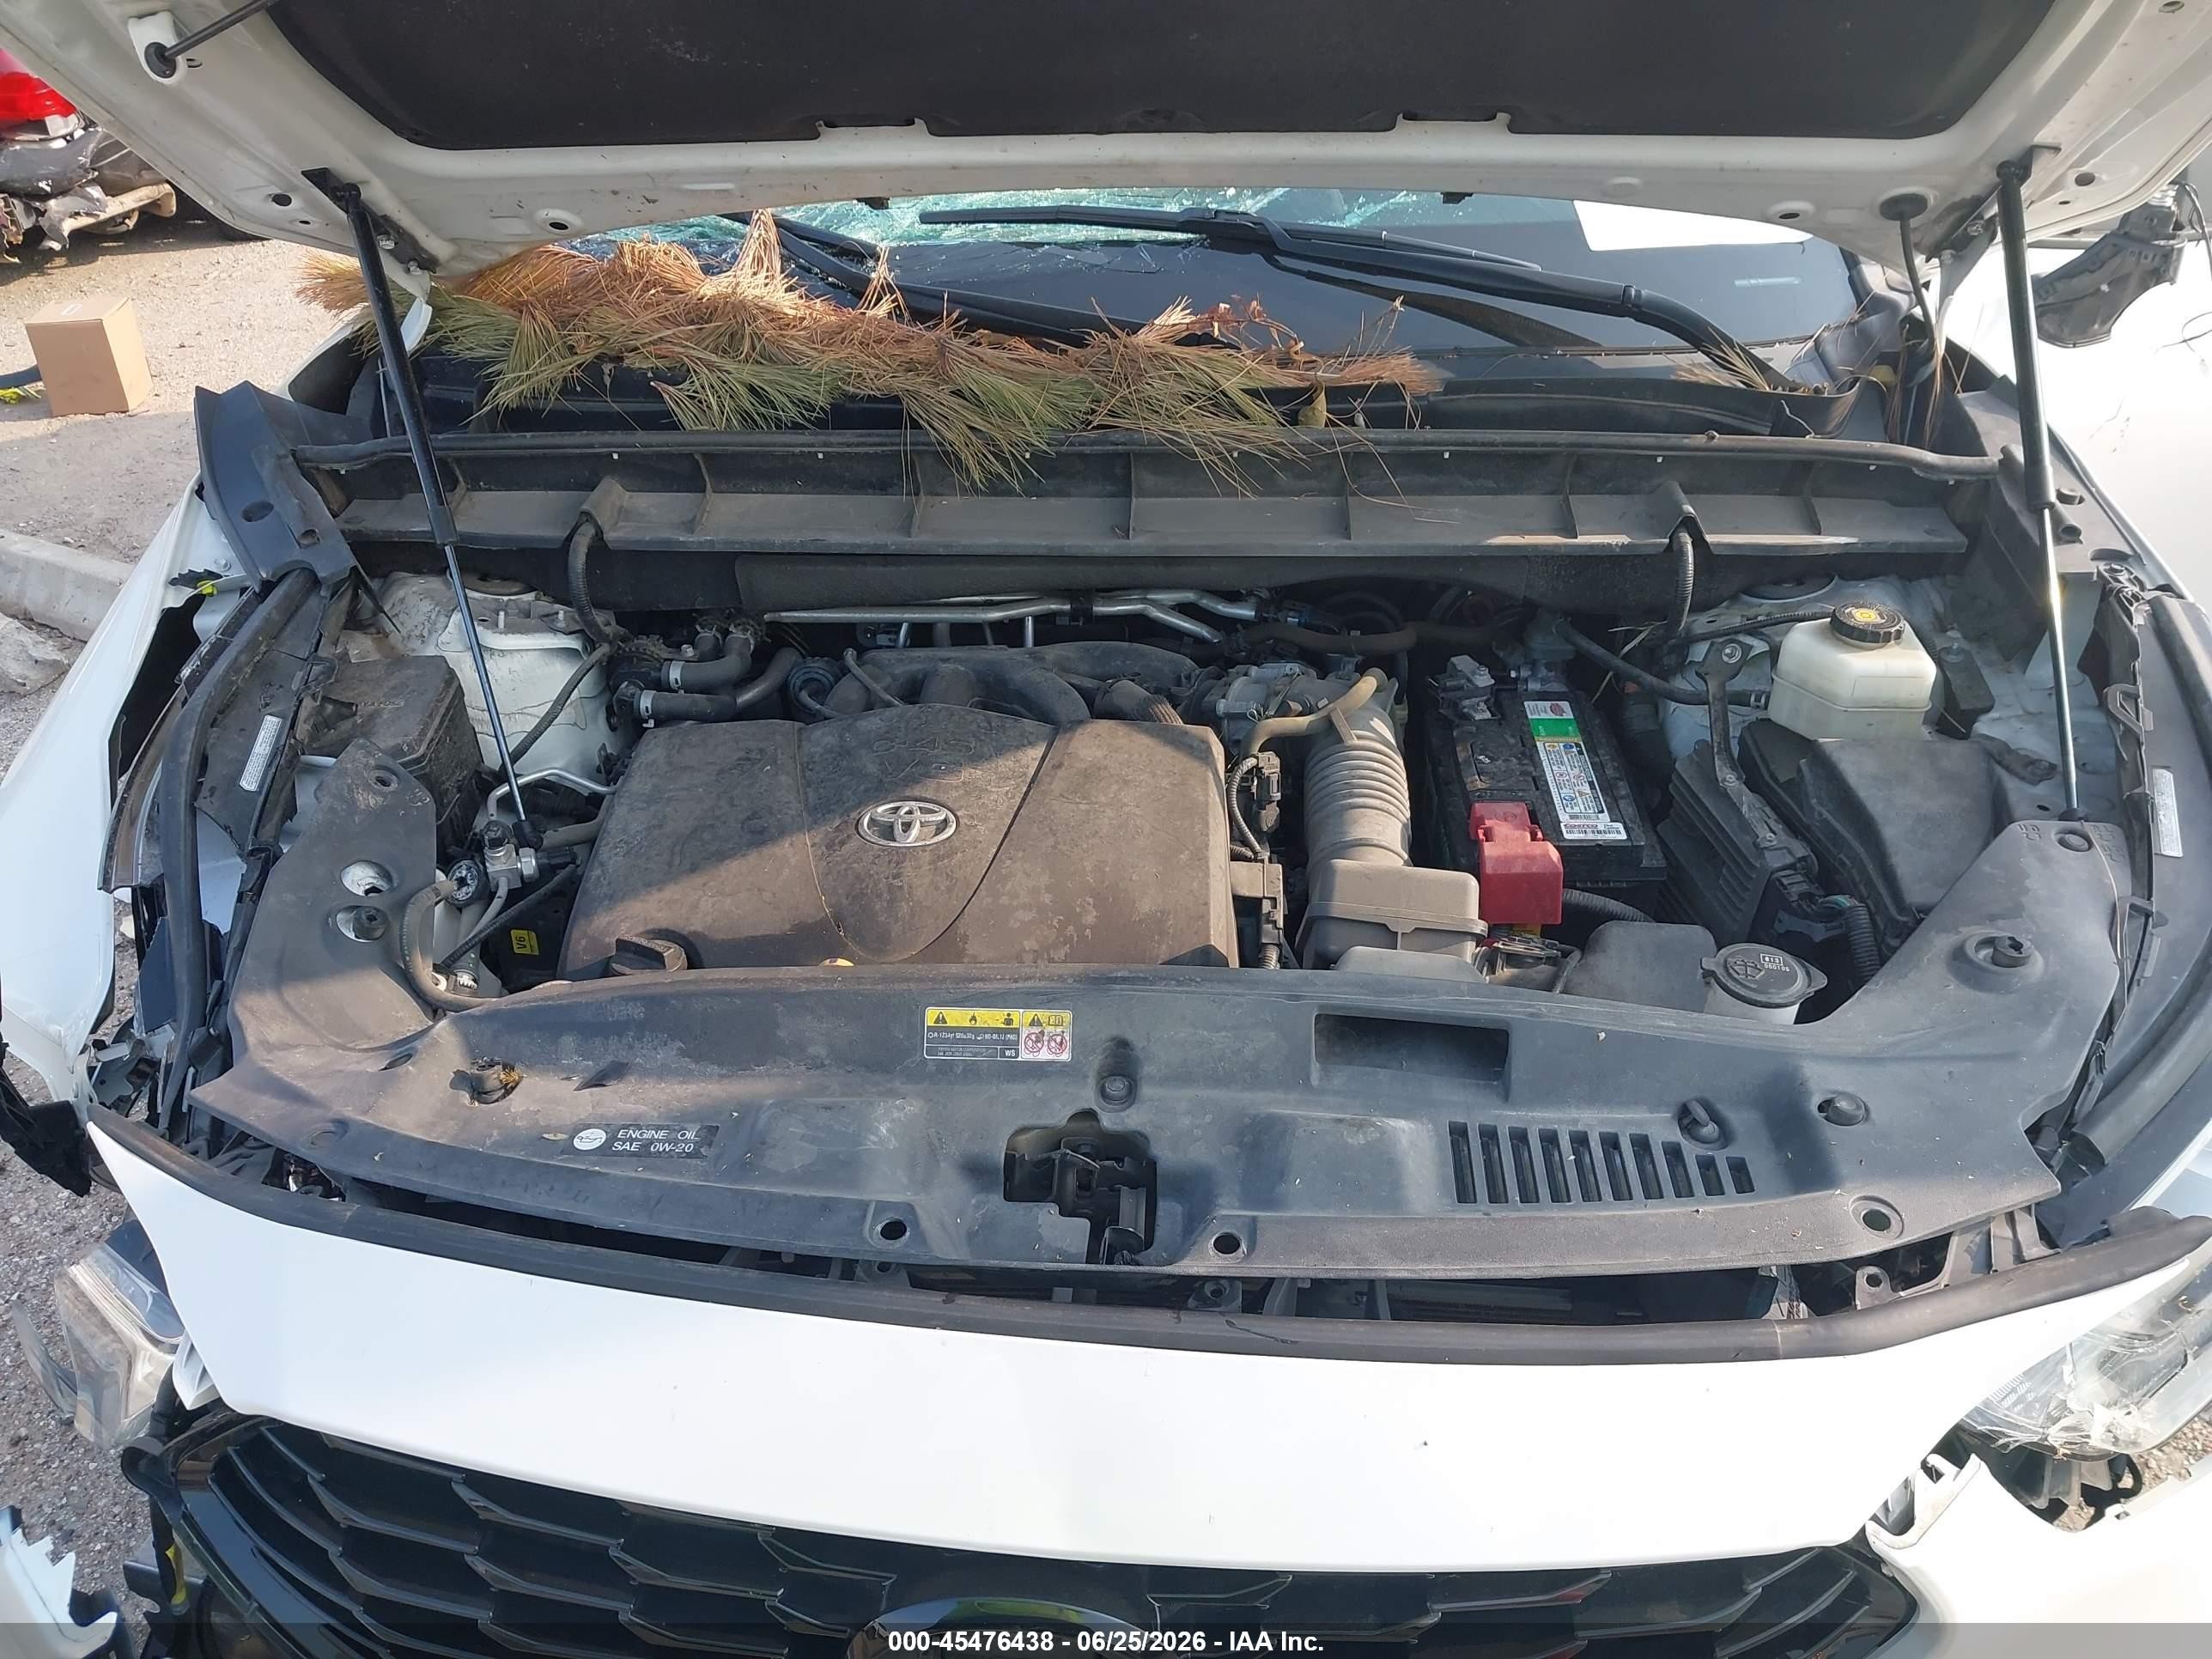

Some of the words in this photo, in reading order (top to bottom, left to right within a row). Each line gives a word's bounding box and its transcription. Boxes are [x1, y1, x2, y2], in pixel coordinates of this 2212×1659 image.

[515, 935, 526, 949] V6
[617, 1129, 670, 1139] ENGINE
[677, 1130, 701, 1140] OIL
[611, 1141, 641, 1152] SAE
[650, 1142, 694, 1152] 0W-20
